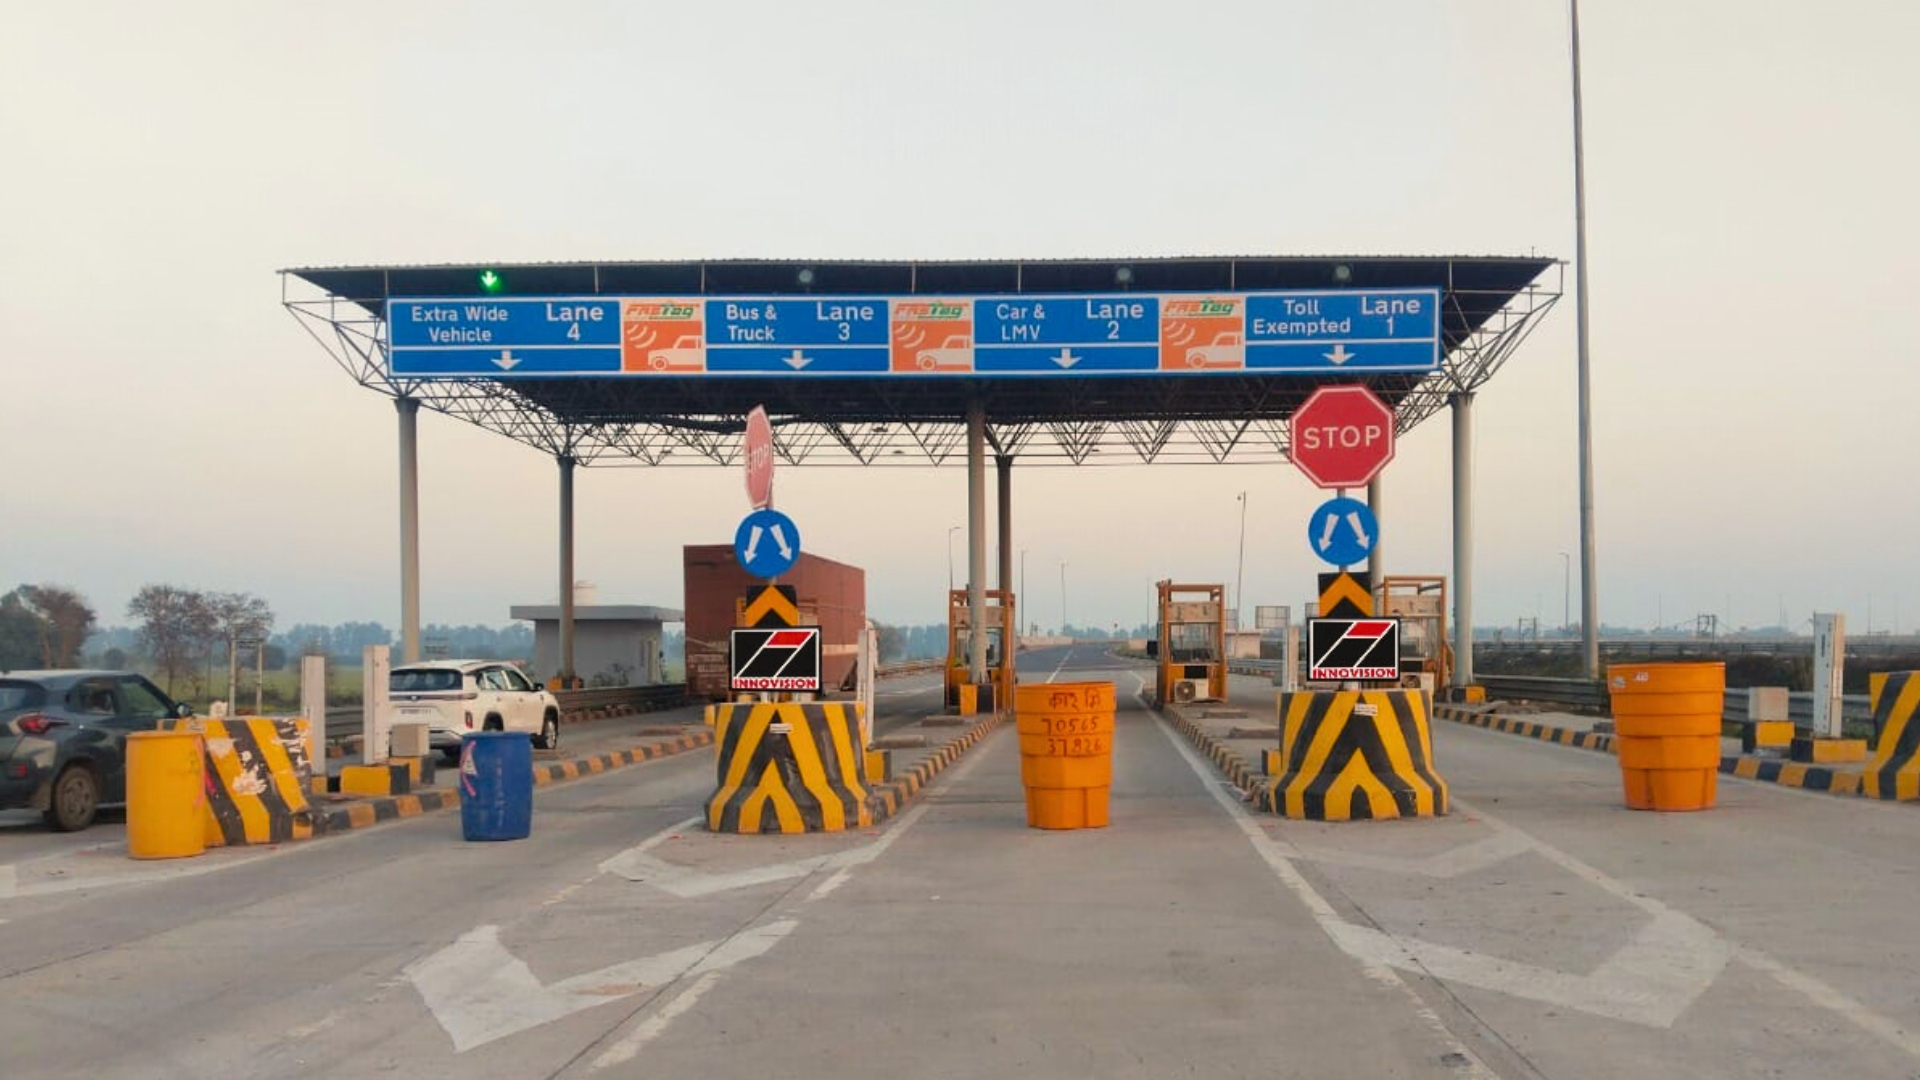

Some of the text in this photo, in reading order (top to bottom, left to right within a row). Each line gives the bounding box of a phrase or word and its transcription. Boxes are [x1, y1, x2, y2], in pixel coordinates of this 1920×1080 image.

[411, 305, 509, 322] Extra Wide
[546, 303, 604, 322] Lane
[726, 304, 778, 320] Bus &
[816, 302, 874, 321] Lane
[996, 303, 1045, 320] Car &
[1087, 300, 1144, 319] Lane
[1284, 299, 1320, 316] Toll
[1361, 296, 1421, 315] Lane
[428, 326, 491, 343] Vehicle
[566, 323, 580, 340] 4
[727, 325, 775, 341] Truck
[838, 323, 850, 340] 3
[1001, 324, 1041, 341] LMV
[1107, 321, 1119, 339] 2
[1253, 318, 1351, 336] Exempted
[1386, 318, 1394, 335] 1
[1303, 425, 1382, 449] STOP
[1312, 668, 1397, 680] INNOVISION
[733, 678, 817, 690] INNOVISION
